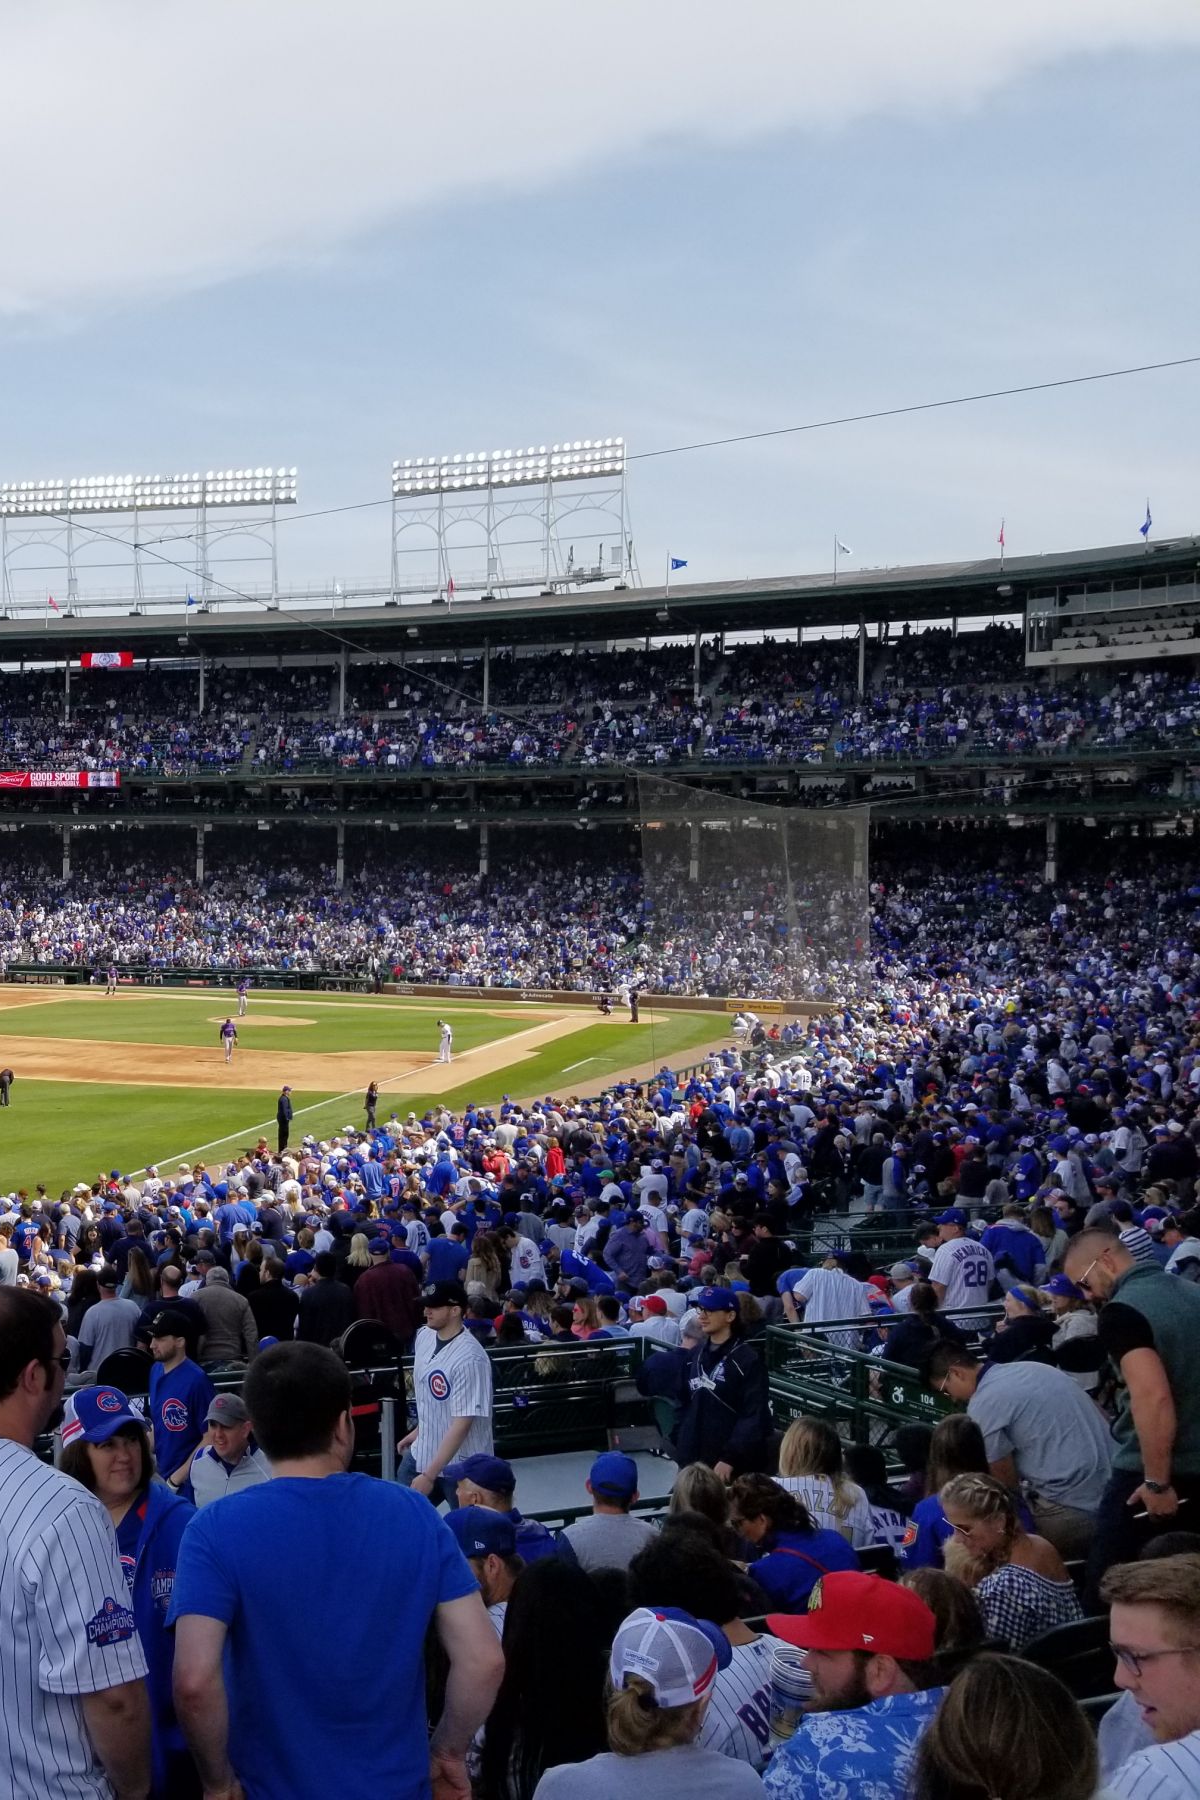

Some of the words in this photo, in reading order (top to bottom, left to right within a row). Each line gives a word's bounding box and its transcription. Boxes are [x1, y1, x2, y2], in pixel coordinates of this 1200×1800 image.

[31, 773, 51, 781] GOOD
[963, 1261, 988, 1288] 28
[920, 1393, 934, 1405] 104
[88, 1614, 135, 1640] CHAMPIONS
